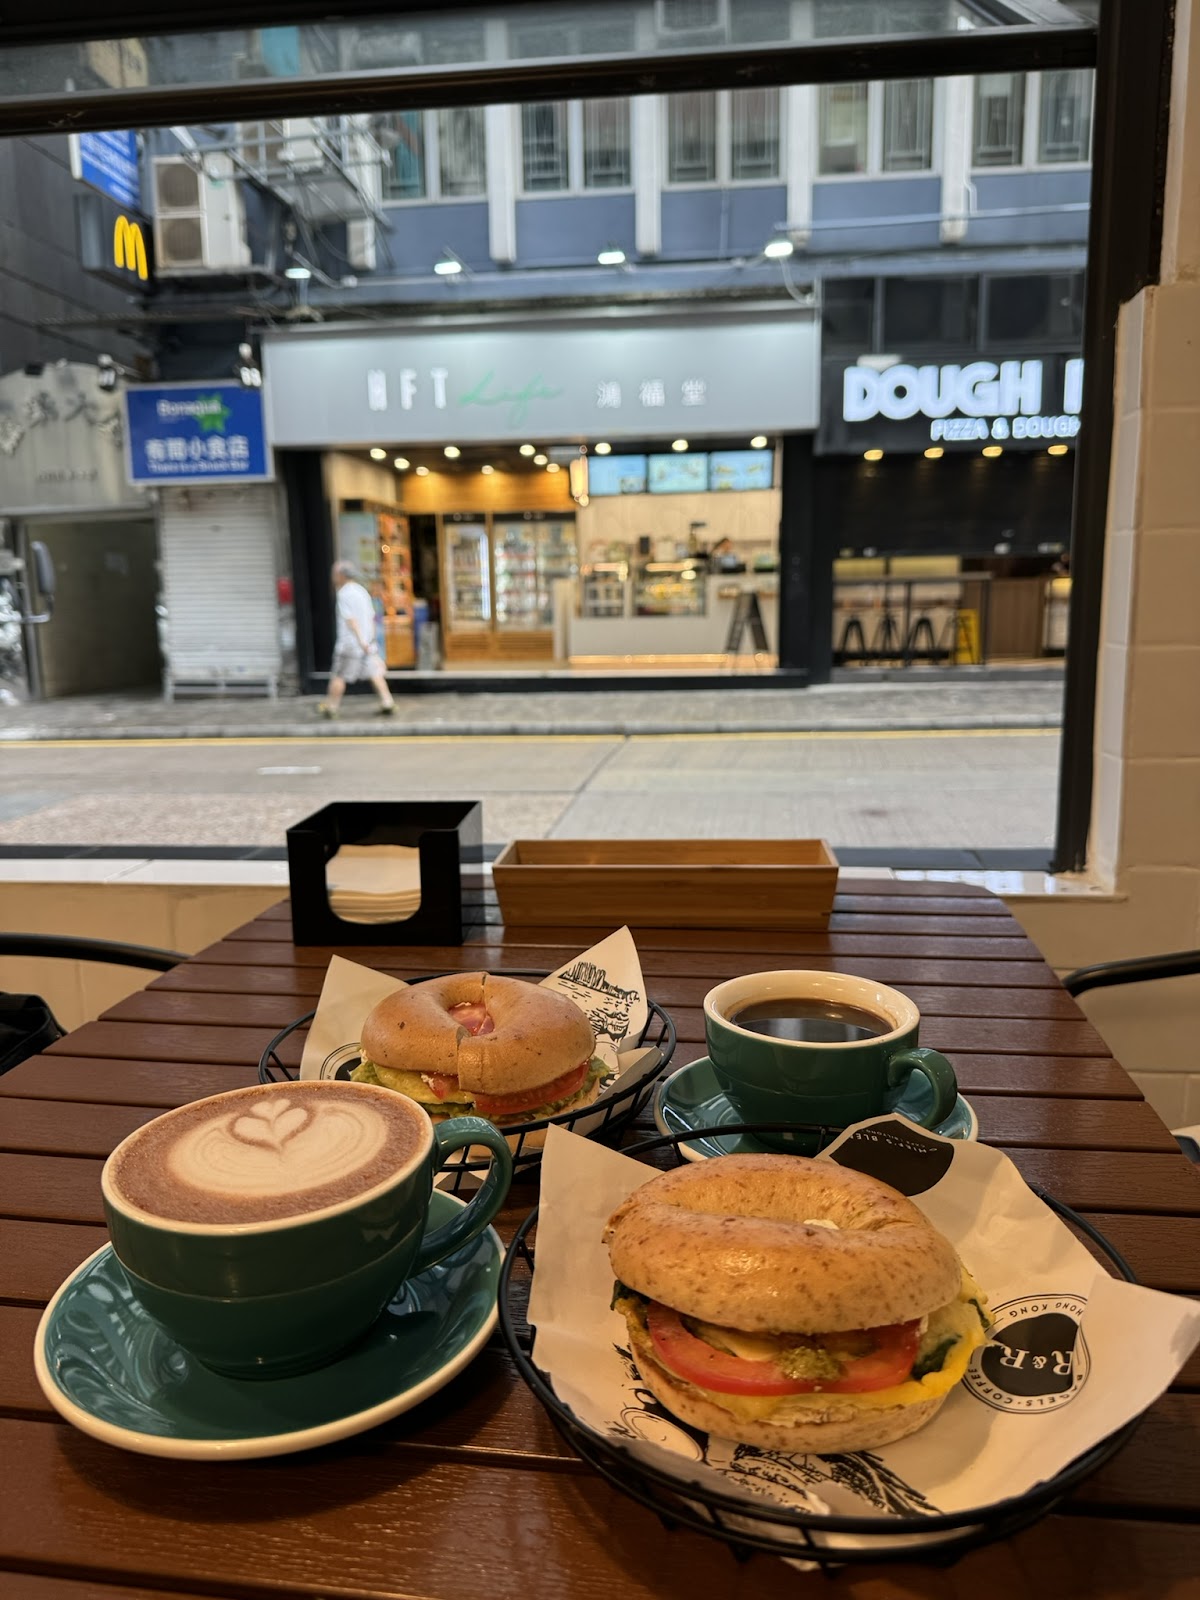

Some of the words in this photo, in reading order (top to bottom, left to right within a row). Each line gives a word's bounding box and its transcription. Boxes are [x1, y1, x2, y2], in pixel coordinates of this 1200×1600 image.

[843, 359, 1043, 422] DOUGH
[930, 418, 989, 441] PIZZA
[991, 417, 1009, 439] &
[1009, 1303, 1048, 1318] KONG
[1055, 1302, 1084, 1317] HONG
[968, 1368, 1013, 1404] COFFEE
